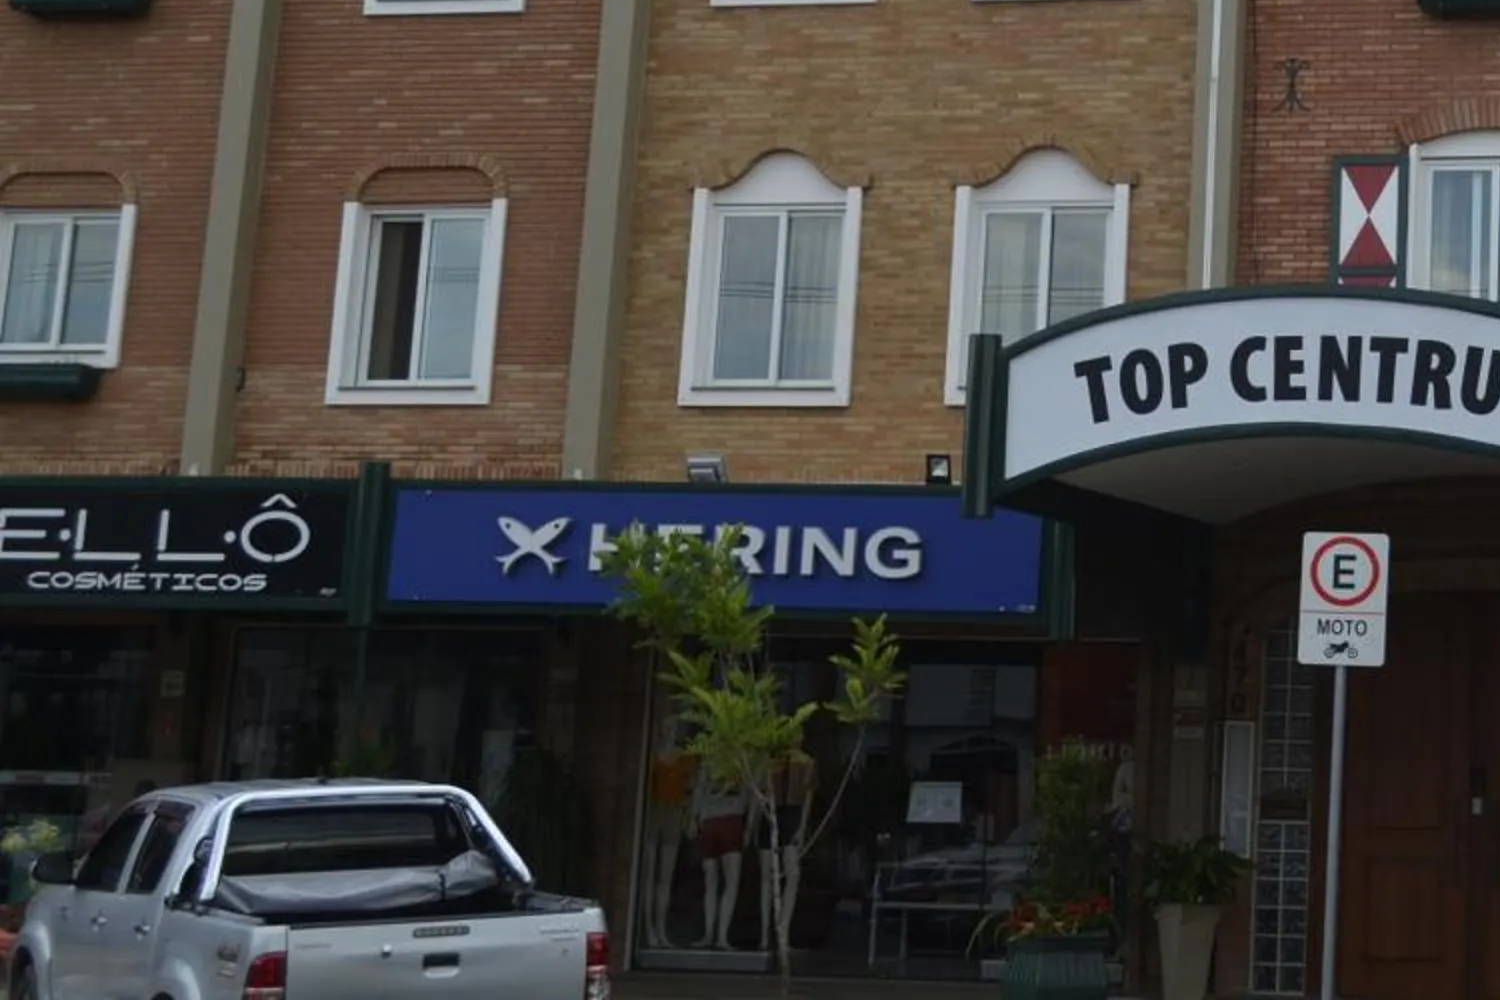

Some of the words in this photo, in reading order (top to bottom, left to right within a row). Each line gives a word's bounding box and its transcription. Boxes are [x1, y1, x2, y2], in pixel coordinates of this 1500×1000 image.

[1074, 342, 1208, 424] TOP
[26, 564, 268, 592] COSMÉTICOS
[1332, 554, 1356, 589] E
[1317, 618, 1367, 636] MOTO
